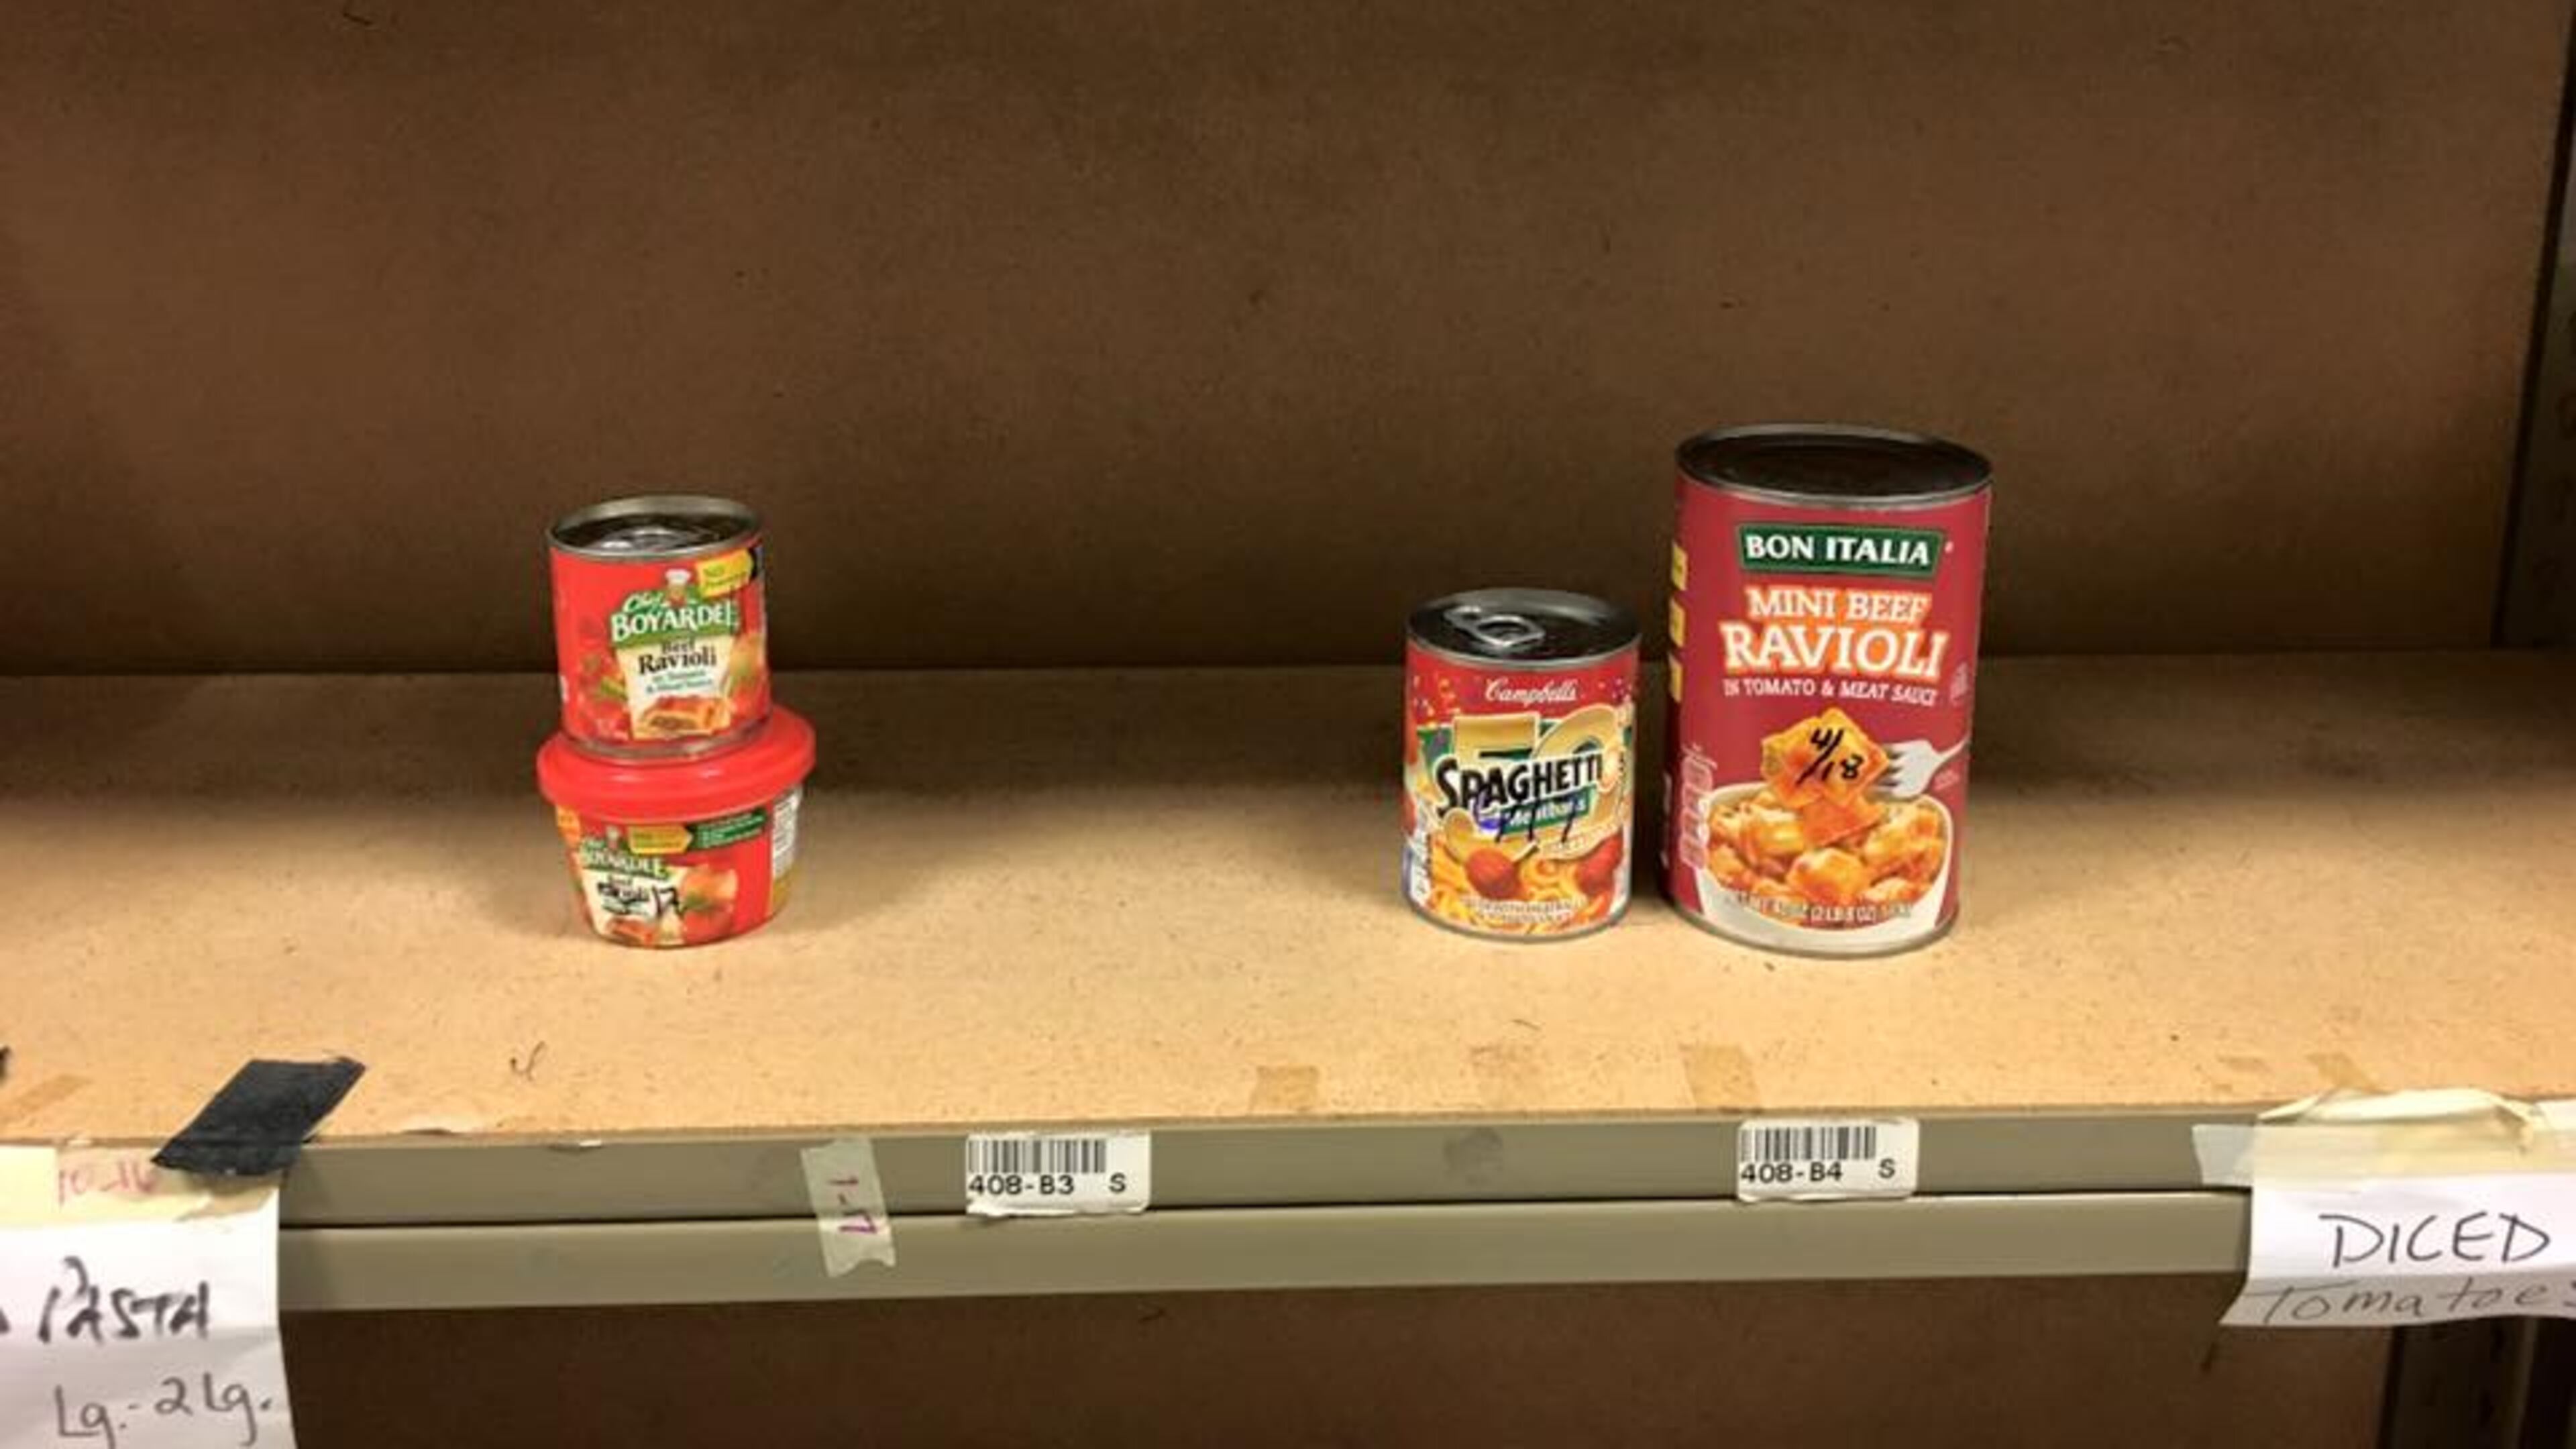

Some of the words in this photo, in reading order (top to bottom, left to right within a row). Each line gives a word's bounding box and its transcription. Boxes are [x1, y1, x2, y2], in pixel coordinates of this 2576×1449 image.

[1745, 535, 1811, 559] BON
[1826, 537, 1930, 566] ITALIA
[1747, 587, 1837, 619] MINI
[1846, 590, 1932, 623] BEEF
[638, 646, 716, 675] Ravioli
[1718, 620, 1950, 679] RAVIOLI
[1724, 678, 1739, 696] IN
[1746, 678, 1816, 696] TOMATO
[1821, 679, 1834, 696] &
[1839, 680, 1888, 698] MEAT
[1795, 727, 1864, 786] 4/18
[968, 1174, 1075, 1195] 408-B3
[1109, 1173, 1126, 1193] S
[1741, 1161, 1843, 1183] 408-B4
[1878, 1158, 1896, 1179] S
[2317, 1210, 2551, 1269] DICED
[38, 1254, 210, 1344] PASTA
